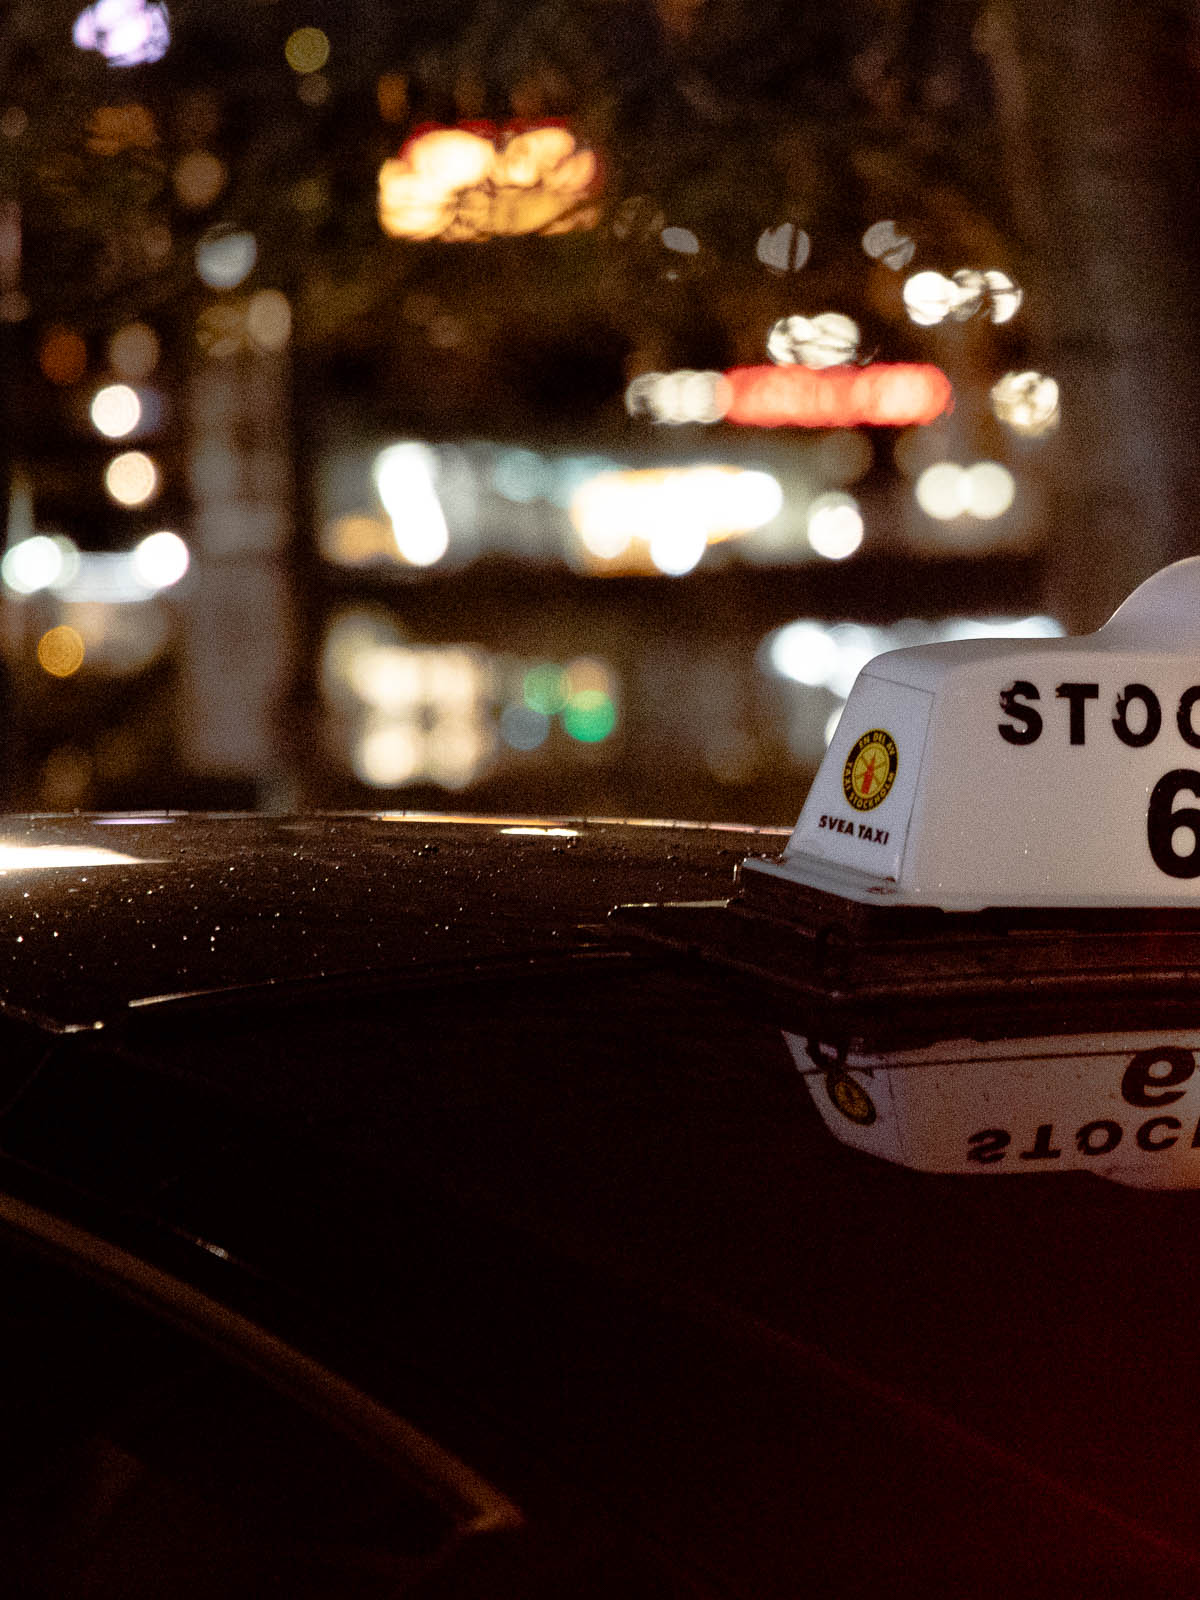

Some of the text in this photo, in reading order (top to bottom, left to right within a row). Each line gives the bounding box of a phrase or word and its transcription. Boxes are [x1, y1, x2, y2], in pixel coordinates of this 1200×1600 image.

[848, 771, 896, 810] STOCKHOLM
[818, 814, 890, 846] SVEA TAXI
